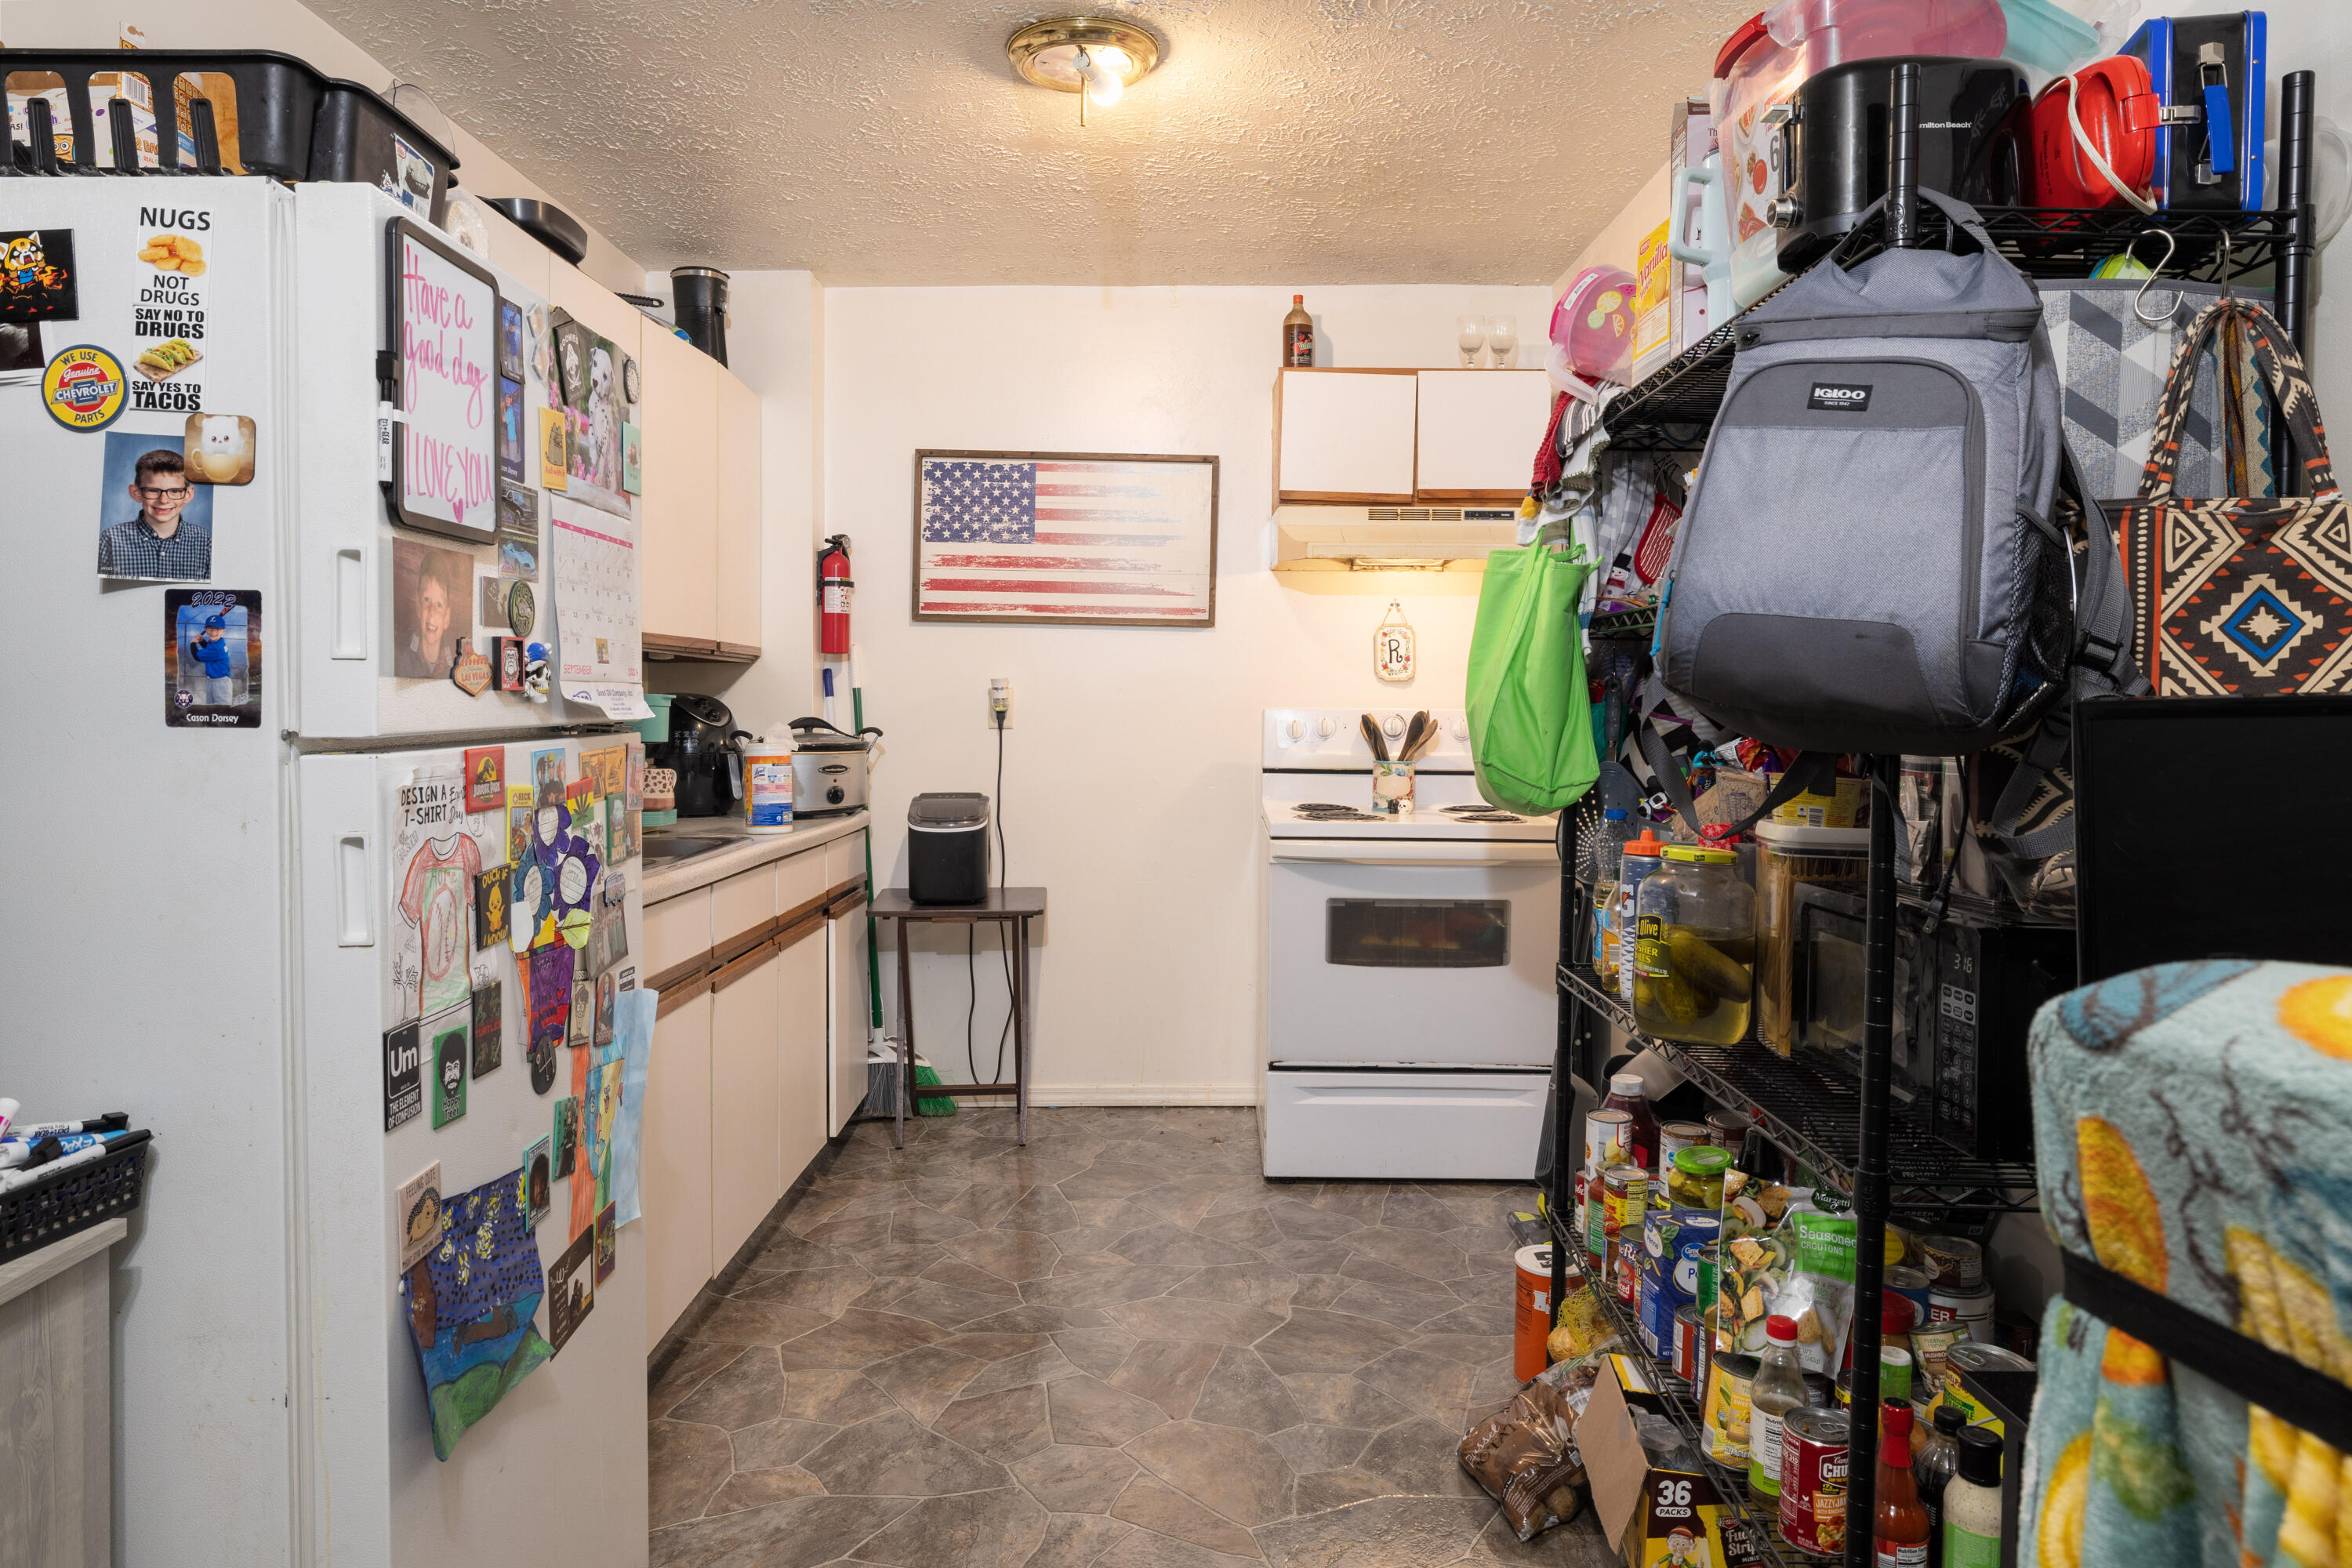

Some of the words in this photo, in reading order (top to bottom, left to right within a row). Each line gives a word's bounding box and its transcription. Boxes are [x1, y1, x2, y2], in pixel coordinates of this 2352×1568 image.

[140, 207, 211, 231] NUGS
[1639, 241, 1668, 285] Vanilla
[154, 274, 190, 290] NOT
[403, 244, 451, 328] Have
[455, 293, 473, 330] a
[140, 289, 200, 307] DRUGS
[135, 308, 161, 320] SAY
[163, 309, 183, 322] NO
[187, 310, 205, 323] TO
[135, 321, 204, 339] DRUGS
[559, 333, 579, 352] GOONIES
[60, 354, 76, 366] WE
[79, 351, 98, 363] USE
[63, 366, 100, 379] Genuine
[404, 321, 448, 414] good
[452, 336, 488, 429] day
[56, 383, 115, 401] CHEVROLET
[132, 380, 158, 391] SAY
[158, 383, 181, 393] YES
[184, 384, 201, 394] TO
[1814, 388, 1865, 399] IGLOO
[132, 392, 201, 411] TACOS
[74, 408, 106, 423] PARTS
[406, 423, 412, 495] I
[416, 431, 457, 503] LOVE
[457, 446, 495, 508] YOU
[191, 591, 237, 608] 2022
[1388, 639, 1403, 663] R
[461, 672, 472, 682] LAS
[472, 670, 490, 681] VEGAS
[564, 664, 592, 675] SEPTEMBER
[187, 713, 209, 724] Cason
[212, 713, 239, 724] Dorsey
[401, 786, 437, 807] DESIGN
[441, 785, 447, 800] A
[518, 792, 532, 801] SICK
[405, 804, 447, 827] T-SHIRT
[448, 806, 463, 824] Day
[481, 870, 500, 887] DUCK
[501, 869, 508, 879] IF
[1640, 920, 1658, 936] Olive
[474, 1016, 502, 1038] TURTLES
[390, 1046, 418, 1078] Um
[389, 1101, 399, 1115] THE
[399, 1089, 419, 1111] ELEMENT
[442, 1094, 461, 1111] Happy
[388, 1117, 395, 1130] OF
[395, 1102, 421, 1125] CONFUSION
[445, 1108, 459, 1121] Trees
[405, 1175, 425, 1200] FEELING
[425, 1167, 437, 1186] CUTE
[1814, 1192, 1851, 1210] Marzetti
[1801, 1240, 1843, 1256] CROUTONS
[1823, 1463, 1849, 1478] CHU
[1657, 1480, 1692, 1505] 36
[1816, 1499, 1835, 1508] JAZZY
